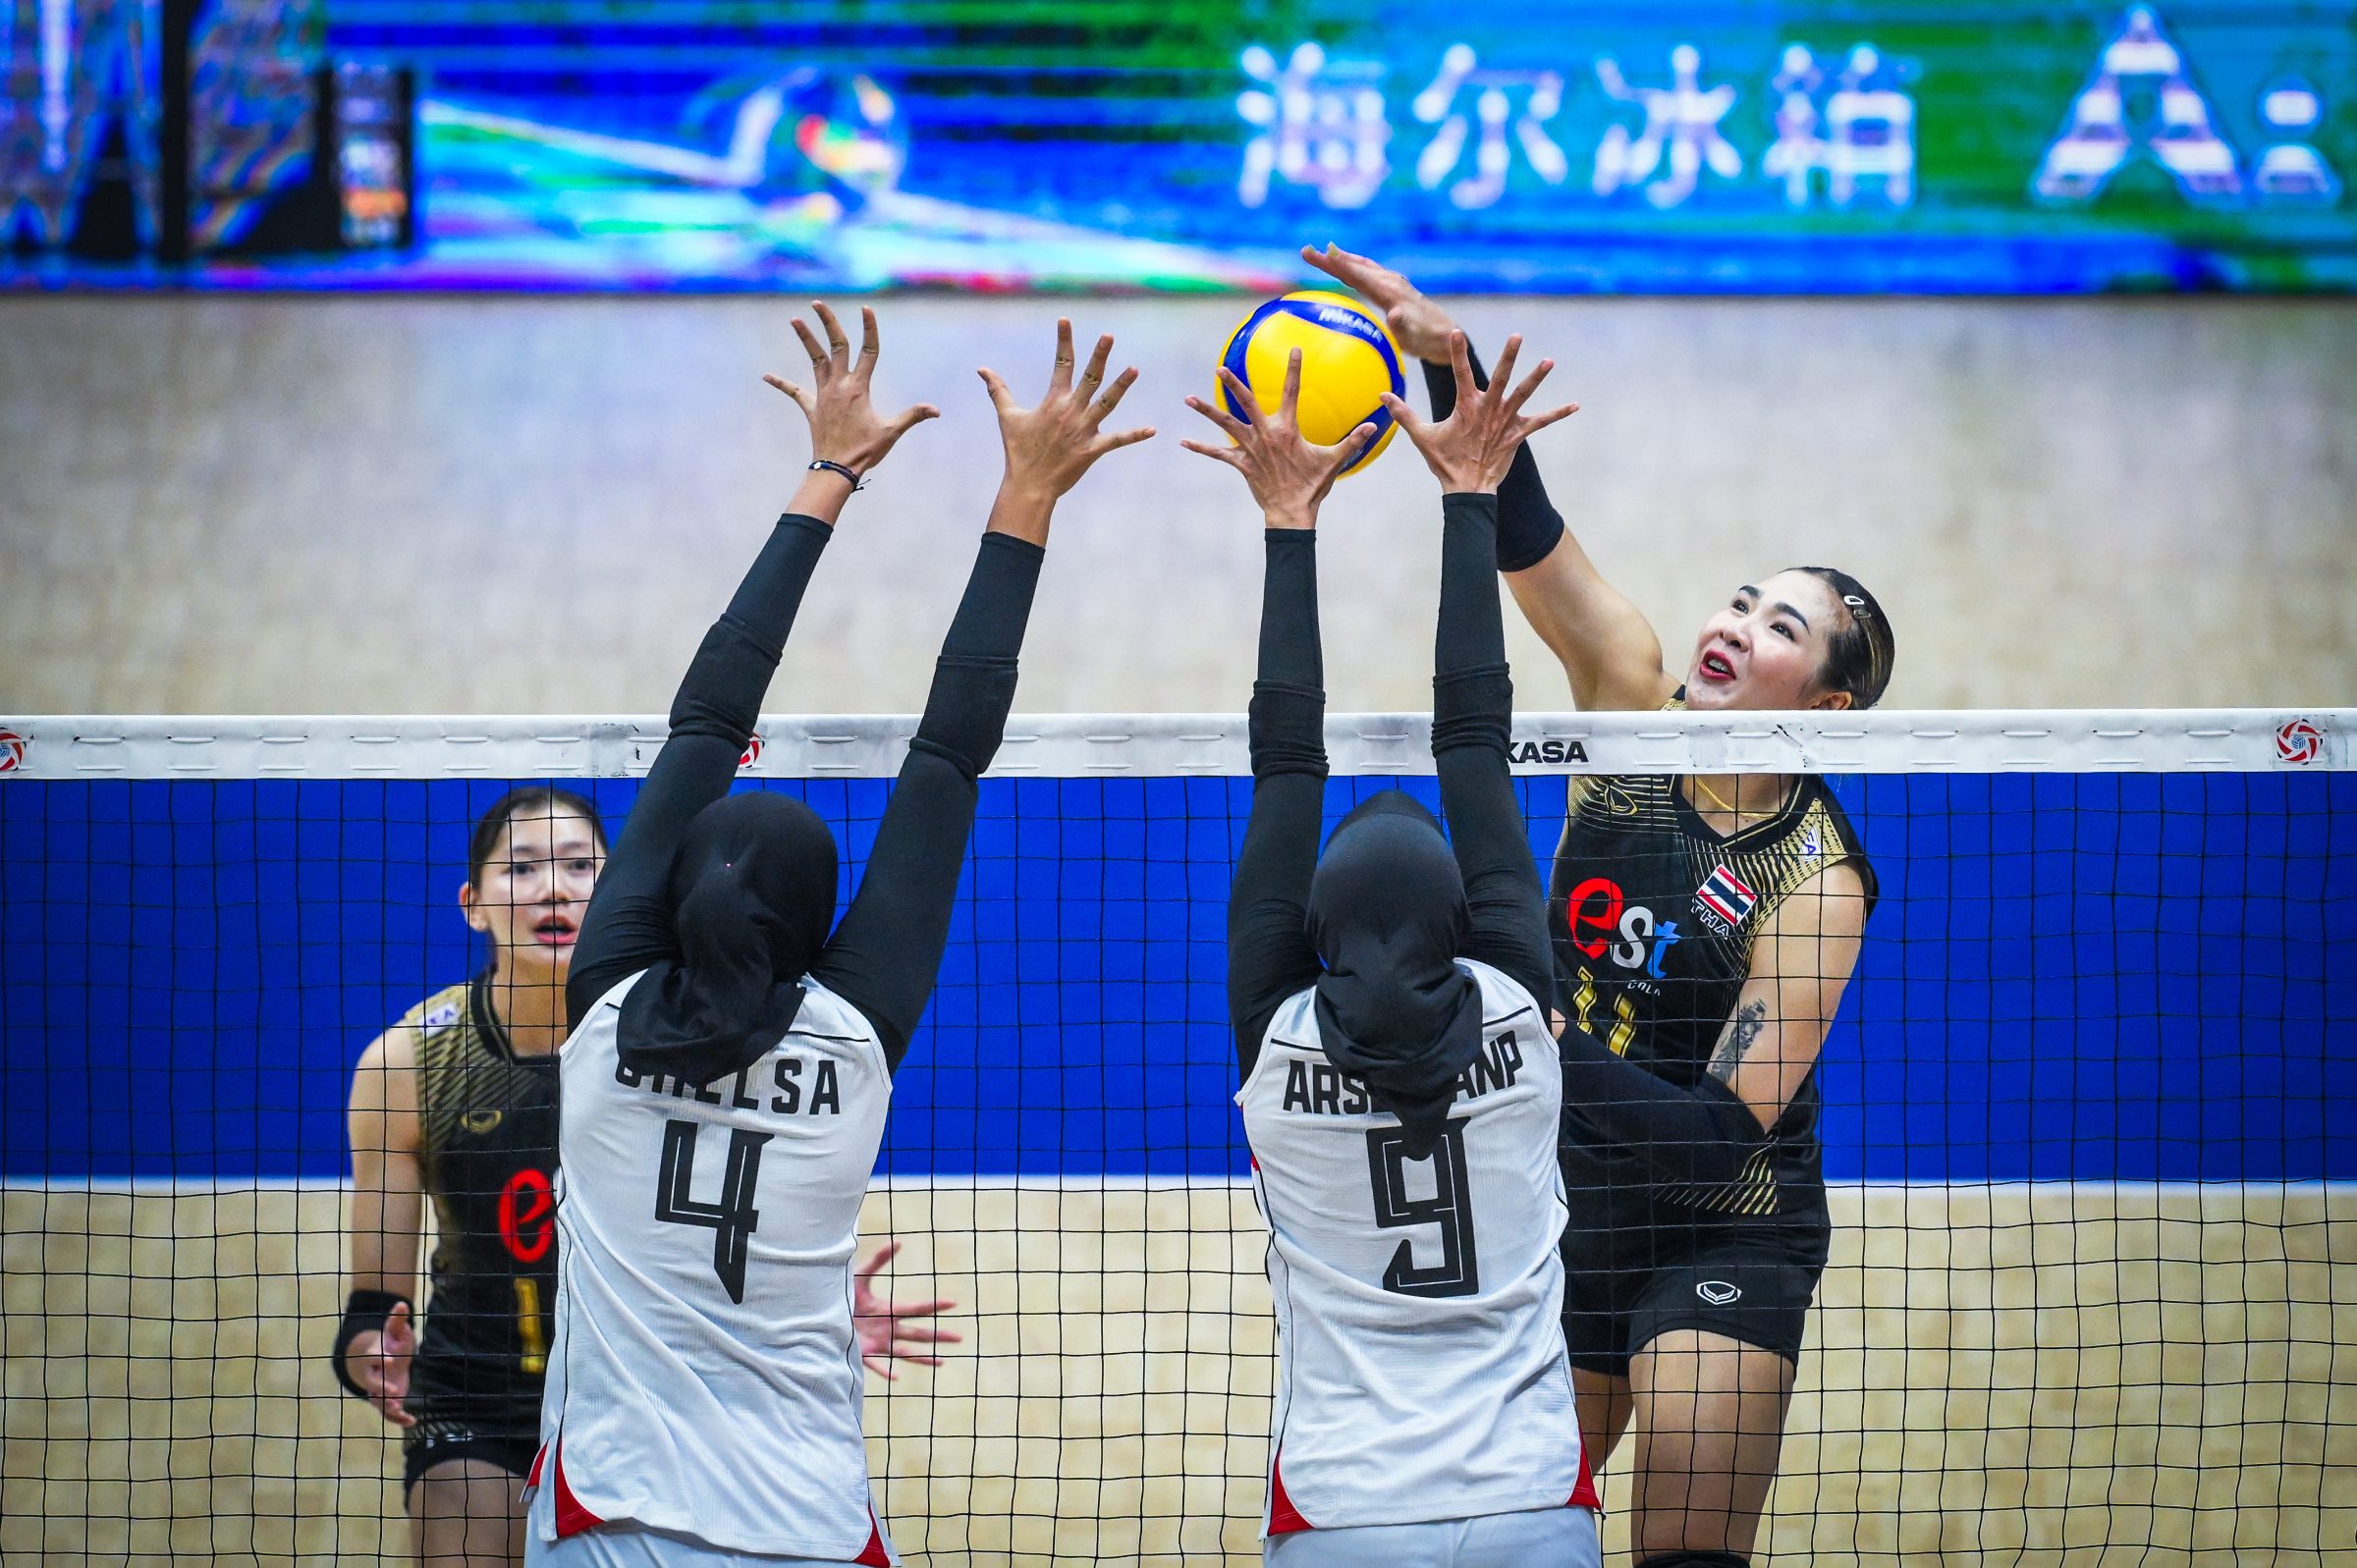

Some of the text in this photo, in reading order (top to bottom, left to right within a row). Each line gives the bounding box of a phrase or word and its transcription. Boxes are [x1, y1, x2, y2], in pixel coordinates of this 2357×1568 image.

[1569, 878, 1681, 979] est
[1690, 897, 1729, 941] THA
[655, 1118, 775, 1305] 4
[1366, 1116, 1480, 1299] 9
